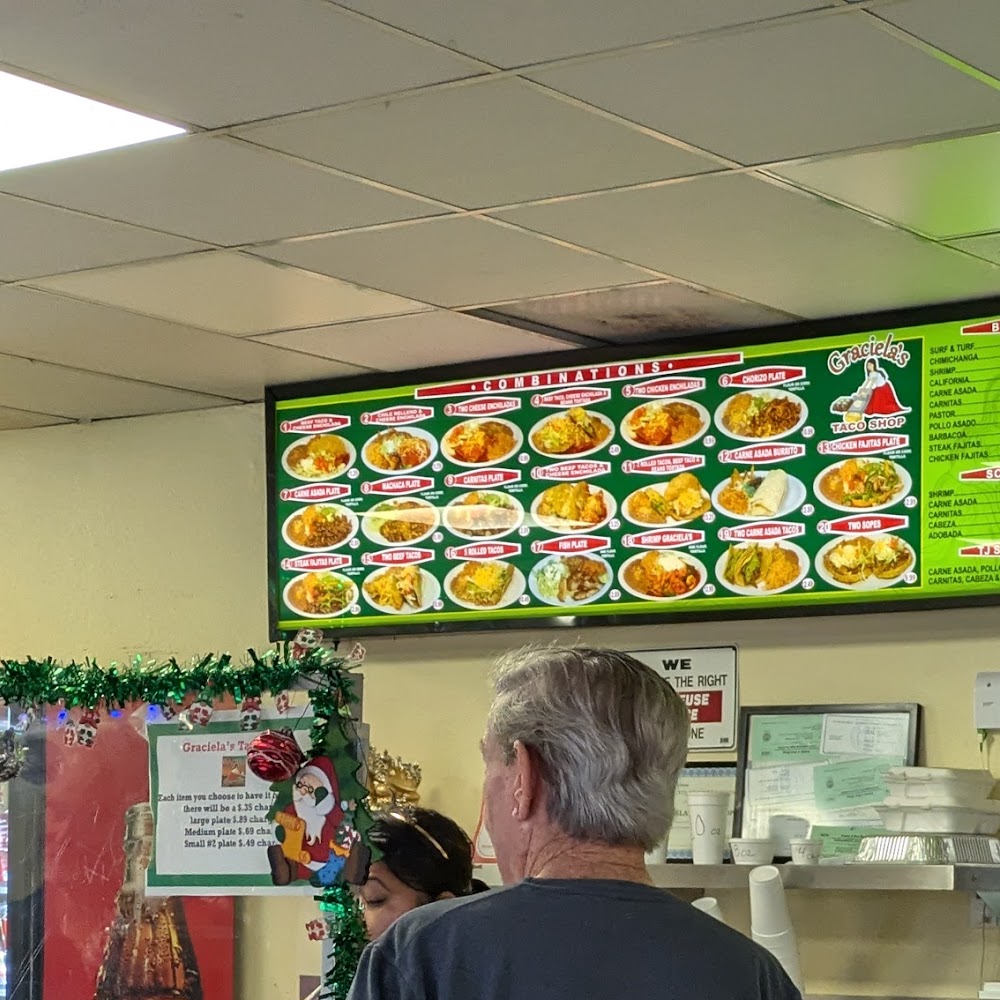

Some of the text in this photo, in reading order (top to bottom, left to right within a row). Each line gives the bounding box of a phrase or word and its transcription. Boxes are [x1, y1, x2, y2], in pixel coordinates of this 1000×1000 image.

[828, 334, 911, 374] Graciela's
[930, 354, 978, 365] CHIMICHANGA
[483, 361, 660, 391] COMBINATIONS
[742, 371, 786, 383] CHORIZO PLATE
[832, 417, 905, 432] TACO SHOP
[463, 472, 503, 483] CARNITAS PLATE
[848, 520, 881, 530] TWO SOPES
[978, 546, 990, 555] TJ
[662, 659, 691, 670] WE
[675, 675, 727, 687] THE RIGHT
[183, 741, 252, 752] Graciela's Ta
[194, 794, 206, 802] you
[208, 792, 235, 800] choose
[204, 804, 218, 812] will
[220, 804, 229, 812] be
[190, 817, 210, 826] large
[212, 816, 231, 825] plate
[185, 828, 215, 836] Medium
[218, 828, 236, 837] plate
[218, 840, 236, 849] plate
